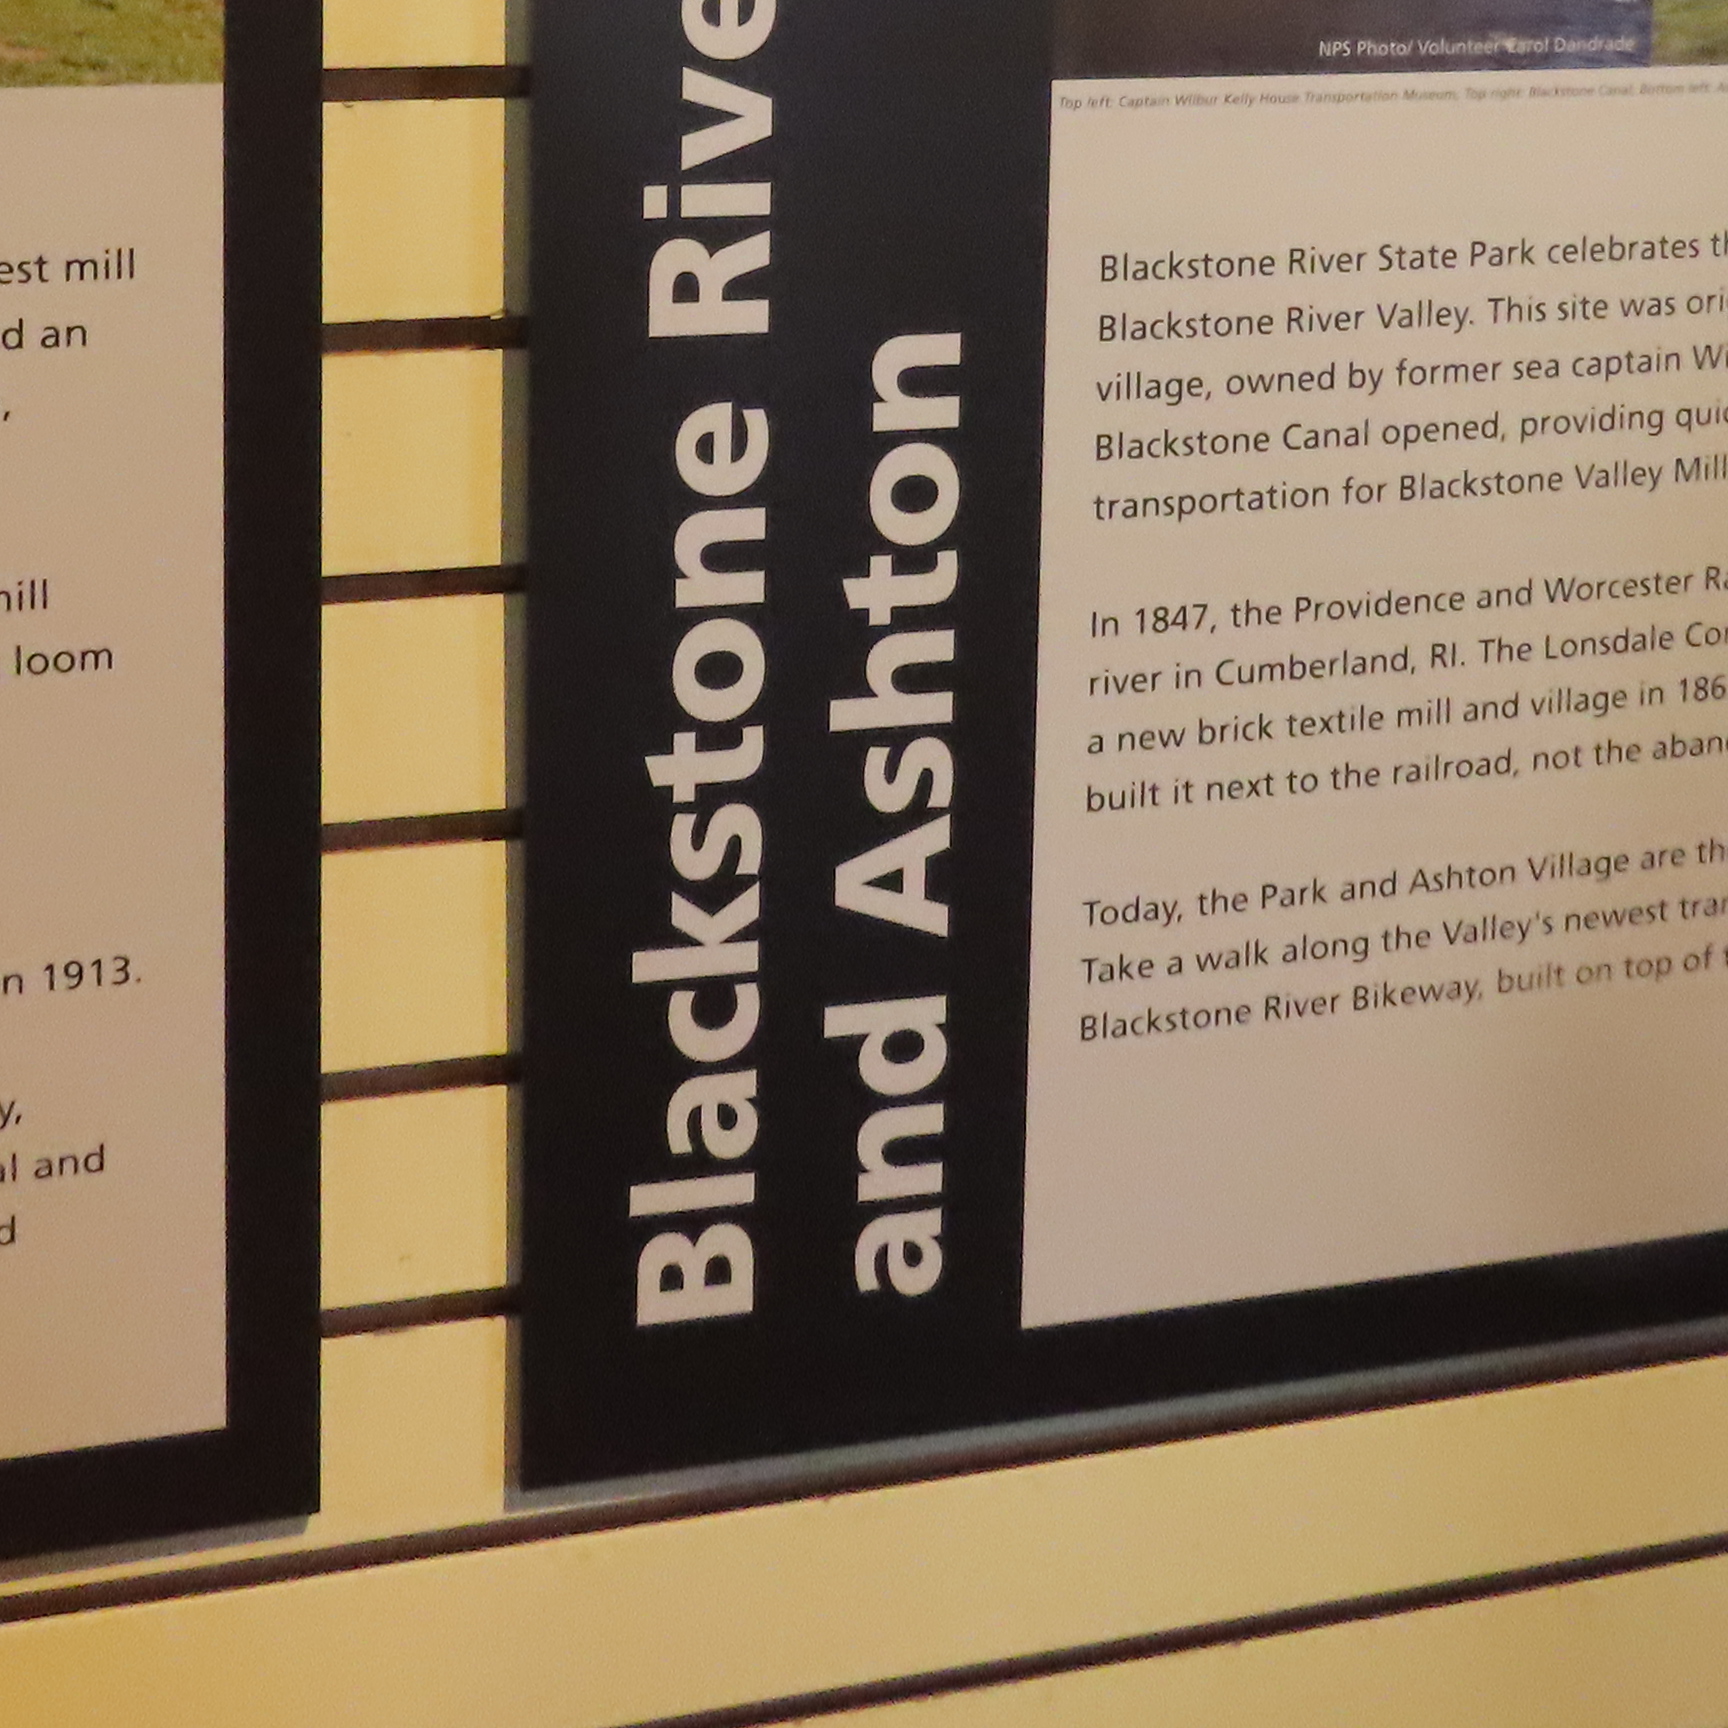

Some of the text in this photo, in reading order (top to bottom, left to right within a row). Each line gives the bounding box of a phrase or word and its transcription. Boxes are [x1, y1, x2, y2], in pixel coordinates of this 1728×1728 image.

[1319, 40, 1351, 57] NPS
[1357, 39, 1413, 57] Photo/
[1417, 38, 1499, 56] Volunteer
[1059, 97, 1083, 111] Top
[1119, 95, 1169, 110] Captain
[1175, 94, 1218, 107] Wilbur
[1224, 93, 1255, 107] Kelly
[1260, 93, 1299, 105] House
[1305, 91, 1398, 105] Transportation
[64, 247, 135, 283] mill
[1100, 250, 1276, 283] Blackstone
[1288, 246, 1367, 275] River
[1378, 243, 1458, 272] State
[1470, 238, 1535, 268] Park
[1547, 234, 1700, 265] celebrates
[1096, 371, 1211, 407] village,
[1226, 361, 1336, 397] owned
[1348, 361, 1384, 396] by
[1396, 357, 1502, 387] former
[1513, 358, 1560, 381] sea
[1571, 347, 1681, 383] captain
[1093, 481, 1329, 522] transportation
[1343, 476, 1388, 505] for
[1399, 469, 1564, 502] Blackstone
[1575, 459, 1663, 493] Valley
[1091, 611, 1120, 639] In
[1135, 602, 1216, 635] 1847,
[1231, 598, 1282, 629] the
[1294, 589, 1465, 623] Providence
[1476, 577, 1533, 610] and
[1544, 572, 1694, 604] Worcester
[824, 333, 961, 1295] and Ashton
[630, 402, 768, 1325] Blackstone
[1080, 1003, 1252, 1043] Blackstone
[1264, 993, 1340, 1021] River
[1352, 979, 1482, 1012] Bikeway,
[1497, 963, 1564, 994] built
[1576, 963, 1612, 985] on
[1624, 956, 1672, 981] top
[1683, 943, 1713, 973] of
[33, 1142, 106, 1181] and
